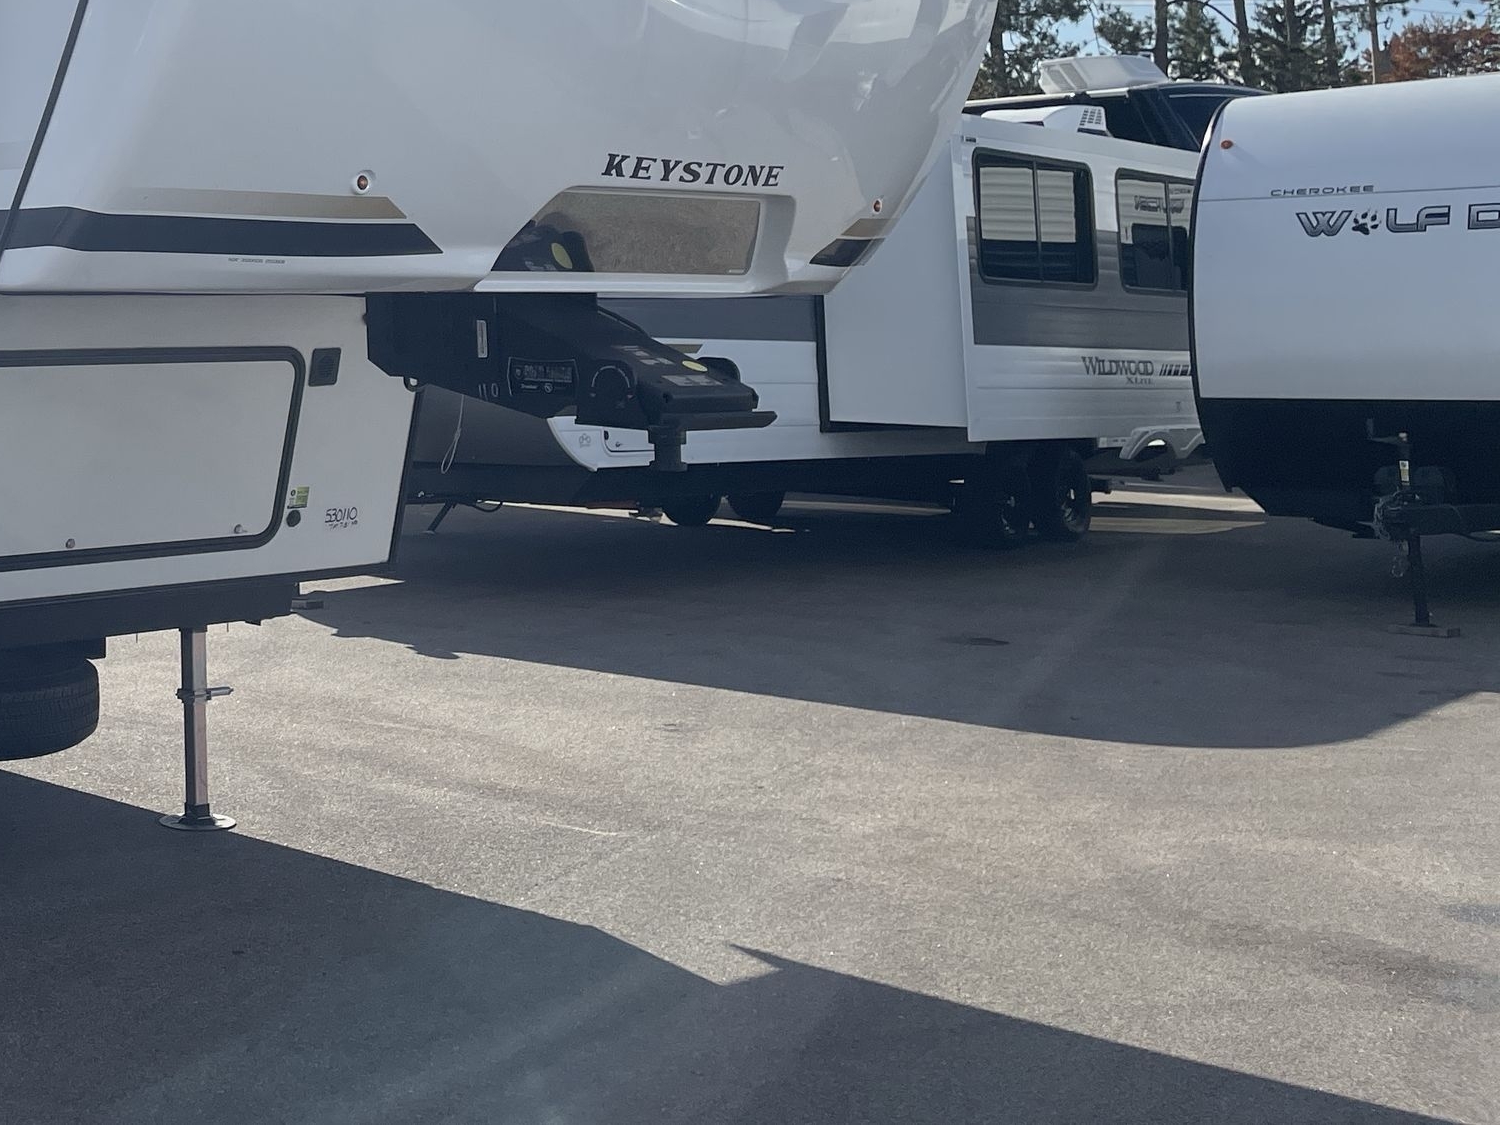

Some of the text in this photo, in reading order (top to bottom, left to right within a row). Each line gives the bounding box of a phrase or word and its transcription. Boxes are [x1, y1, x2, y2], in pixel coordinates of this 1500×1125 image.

[601, 153, 784, 187] KEYSTONE
[1270, 185, 1374, 197] CHEROKEE
[1081, 356, 1154, 376] WILDWOOD
